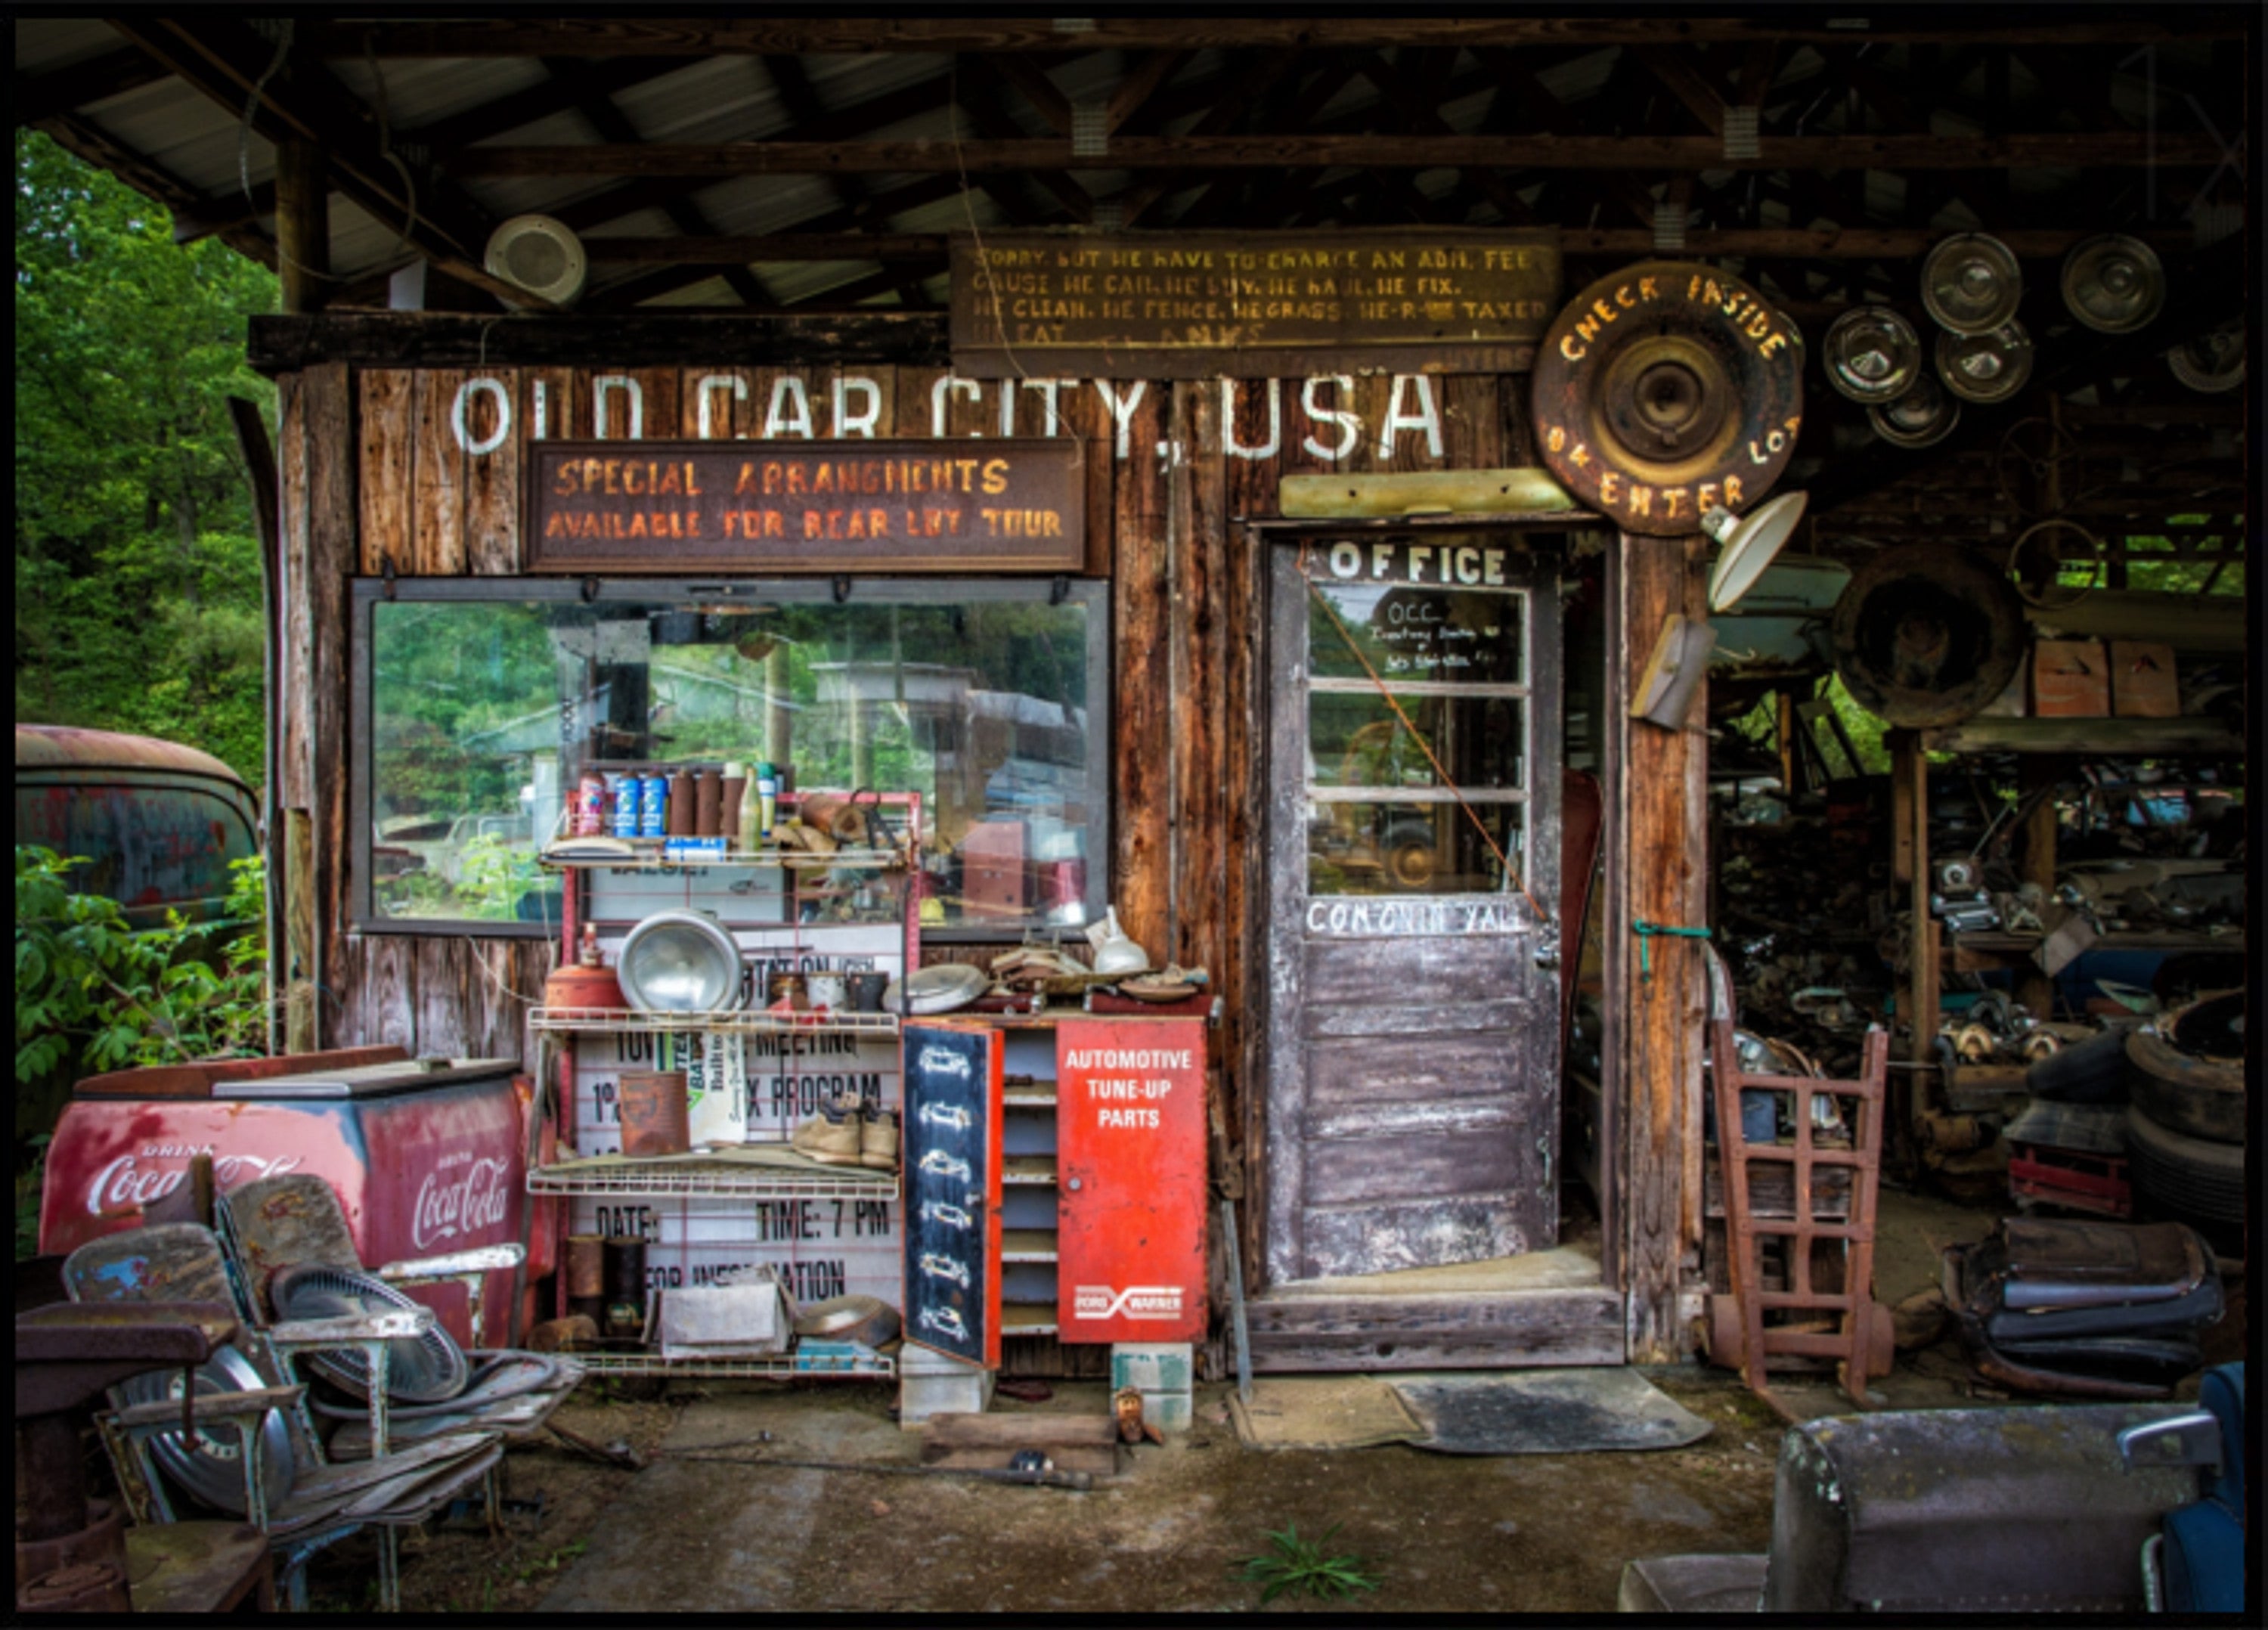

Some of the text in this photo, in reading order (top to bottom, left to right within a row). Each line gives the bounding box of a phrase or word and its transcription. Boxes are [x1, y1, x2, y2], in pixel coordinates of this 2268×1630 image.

[1372, 250, 1405, 269] AN
[1485, 249, 1533, 270] FEE
[1560, 274, 1786, 361] CHECK INSIDE
[697, 375, 881, 439] CAR
[1221, 374, 1443, 460] USA
[554, 458, 702, 496] SPECIAL
[1600, 471, 1743, 519] ENTER
[1748, 415, 1802, 464] LOT
[545, 511, 701, 538] AVAILABLE
[723, 510, 785, 539] FOR
[803, 508, 889, 540] REAR
[981, 508, 1062, 537] TOUR
[1330, 541, 1507, 585] OFFICE
[1065, 1049, 1191, 1070] AUTOMOTIVE
[1086, 1079, 1173, 1099] TUNE-UP
[1098, 1109, 1160, 1129] PARTS
[142, 1145, 215, 1157] DRINK
[758, 1200, 821, 1241] TIME:
[830, 1200, 843, 1238] 7
[854, 1198, 891, 1235] PM
